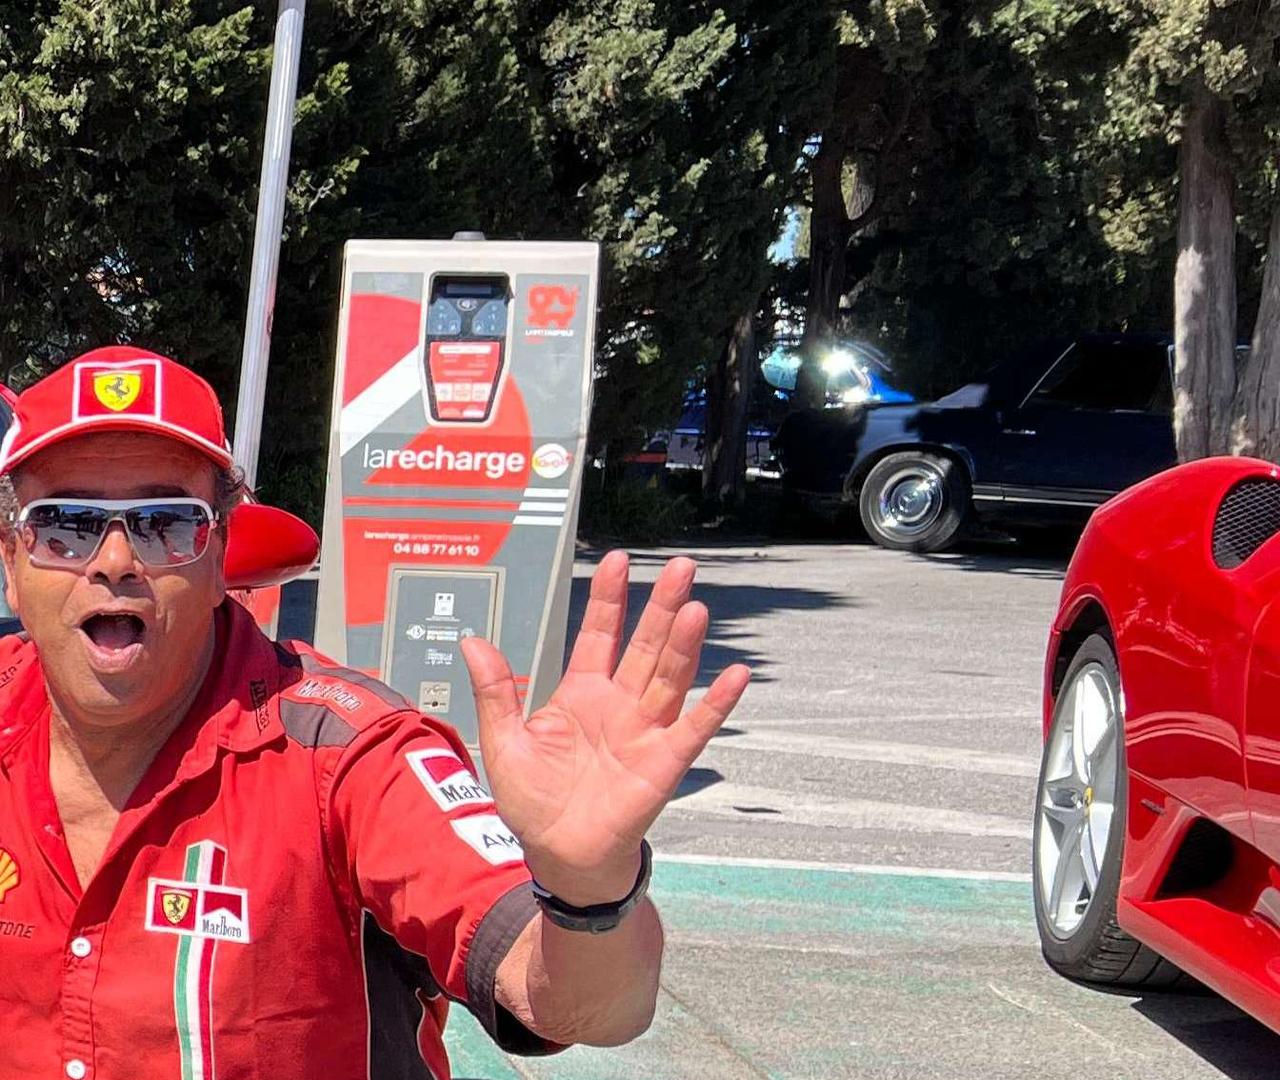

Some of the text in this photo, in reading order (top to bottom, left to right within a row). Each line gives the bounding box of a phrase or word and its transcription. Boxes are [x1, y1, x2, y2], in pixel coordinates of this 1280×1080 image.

[362, 442, 526, 479] larecharge
[393, 542, 411, 555] 04
[202, 915, 242, 938] Marlboro
